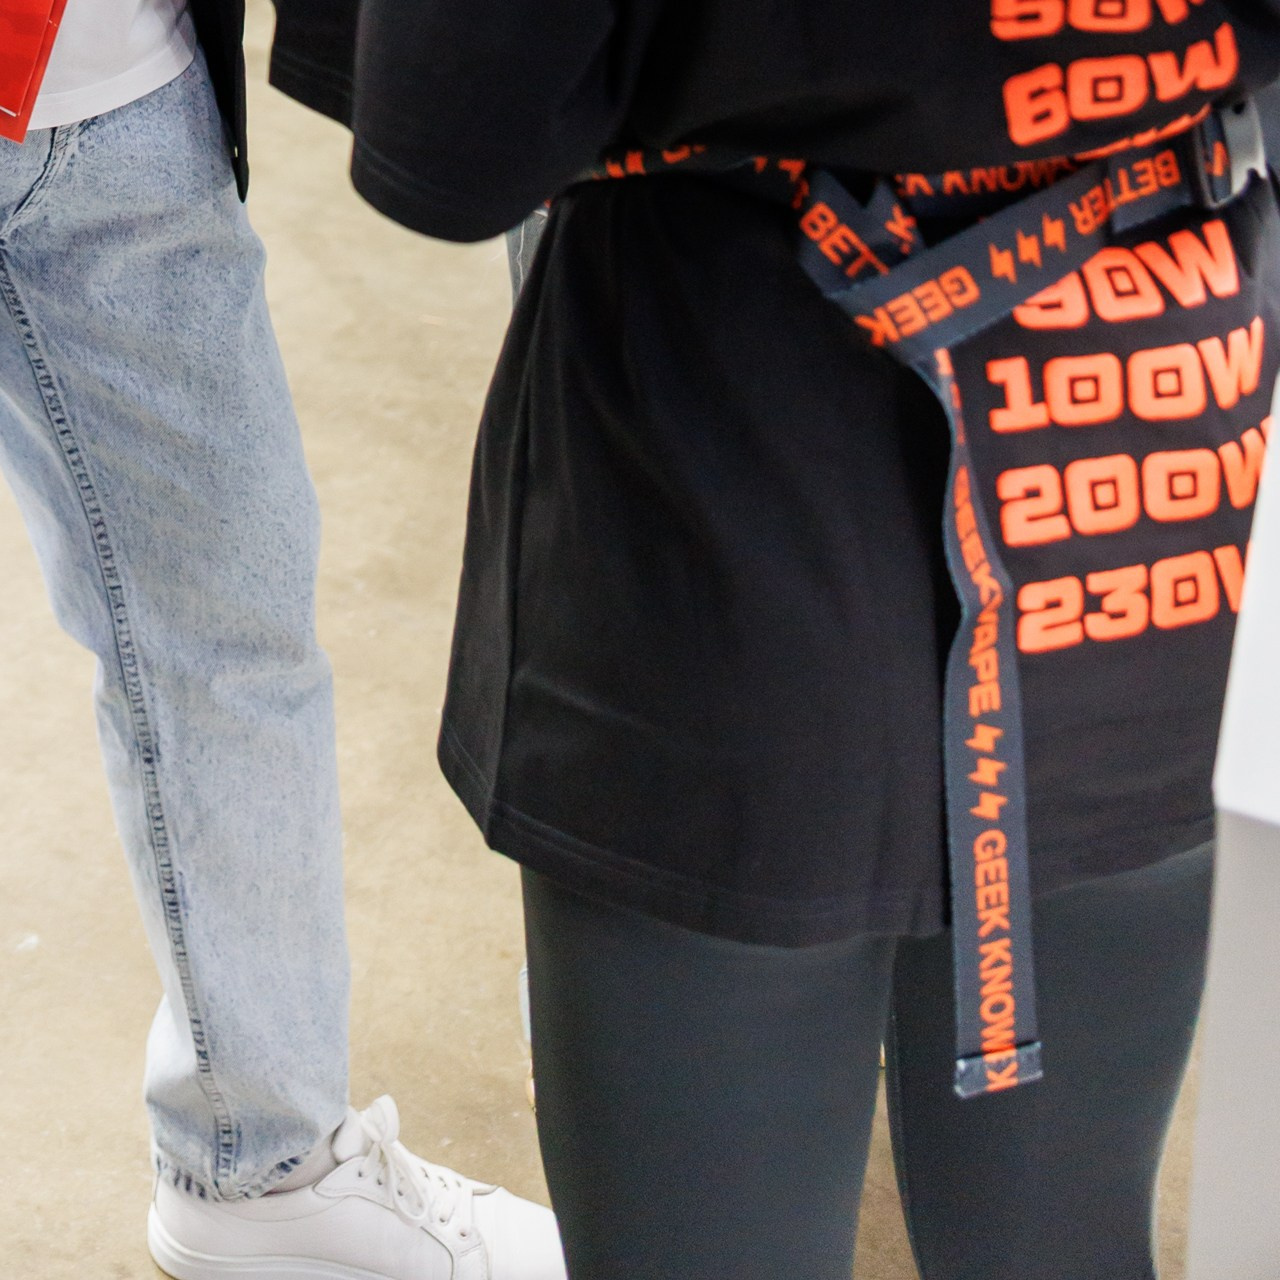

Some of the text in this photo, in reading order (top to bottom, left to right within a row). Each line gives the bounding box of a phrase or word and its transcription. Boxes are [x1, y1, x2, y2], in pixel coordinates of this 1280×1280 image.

[1002, 22, 1238, 145] 60W
[800, 201, 890, 278] BET
[855, 149, 1182, 346] BETTER GEEK
[985, 317, 1264, 433] 100W
[996, 416, 1273, 548] 200W
[973, 829, 1010, 938] GEEK
